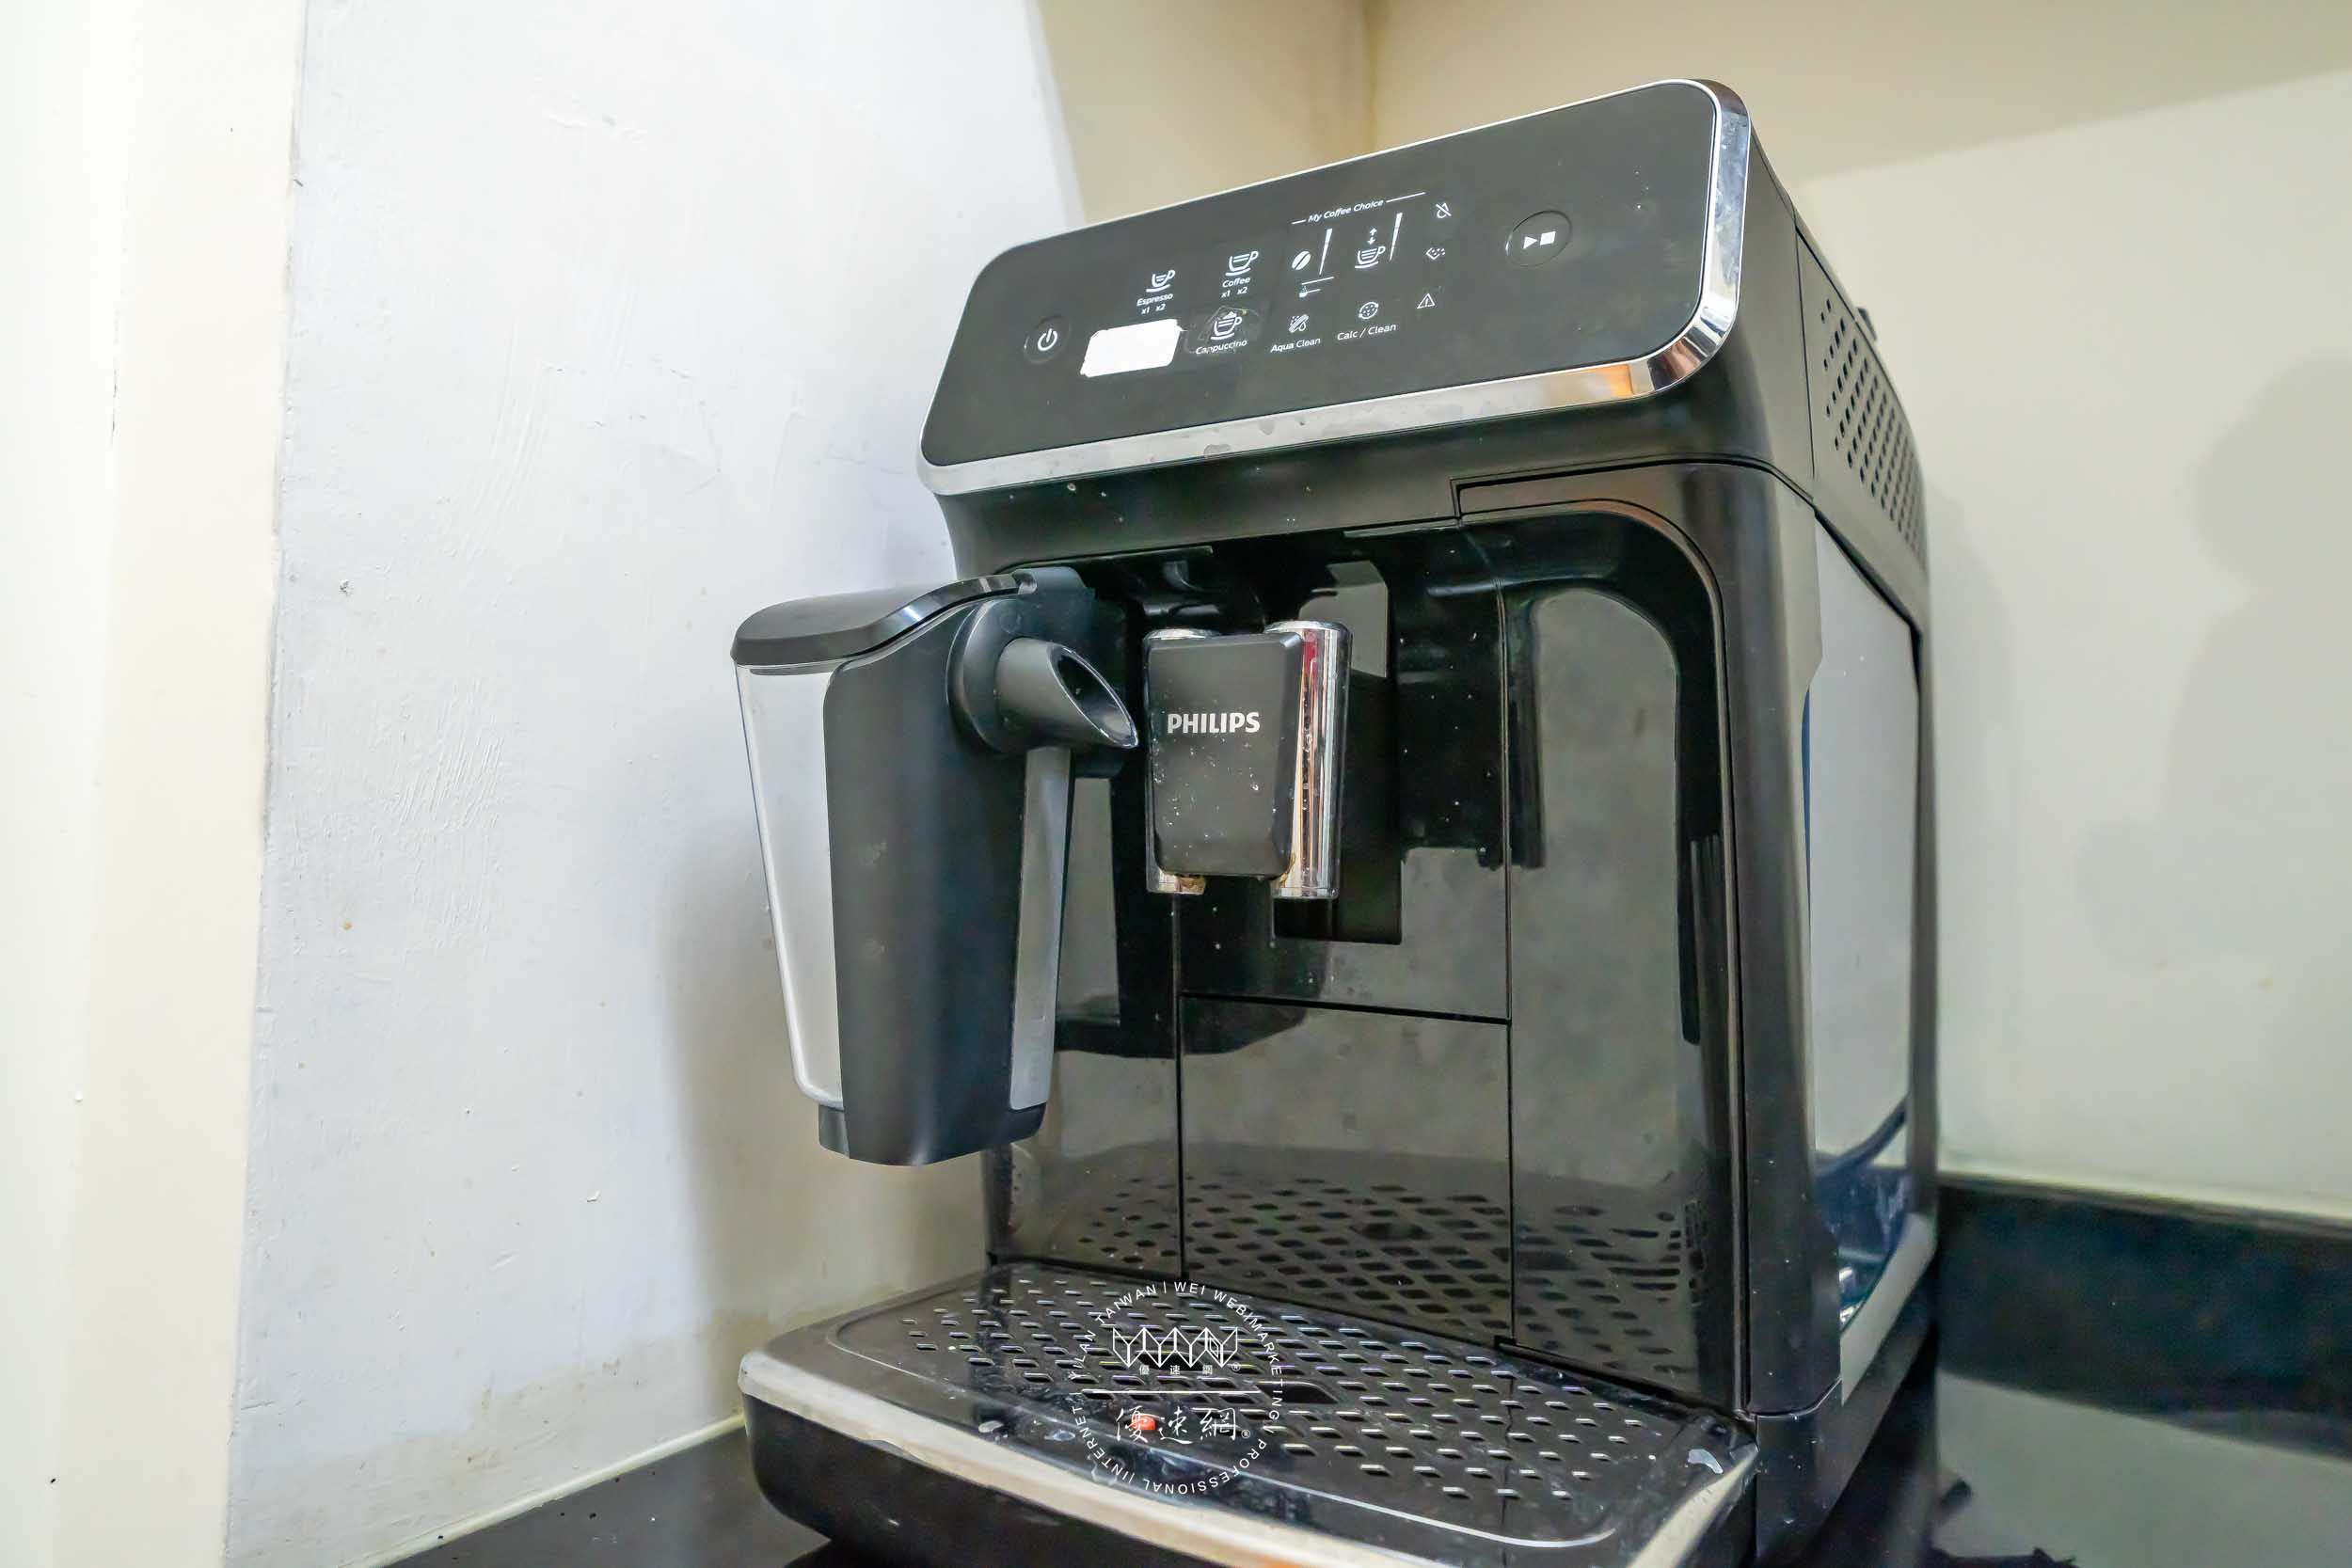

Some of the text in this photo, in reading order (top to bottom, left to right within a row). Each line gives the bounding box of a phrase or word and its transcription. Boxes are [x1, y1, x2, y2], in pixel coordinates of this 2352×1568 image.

[1308, 199, 1384, 223] My Coffee Choice
[1222, 276, 1250, 288] Coffee
[1221, 286, 1248, 298] x1 x2
[1136, 293, 1174, 307] Espresso
[1140, 303, 1167, 315] x1 x2
[1337, 330, 1359, 341] Calc
[1368, 324, 1397, 335] Clean
[1196, 340, 1248, 355] Cappuccino
[1270, 338, 1321, 353] Aqua Clean
[1167, 711, 1261, 734] PHILIPS
